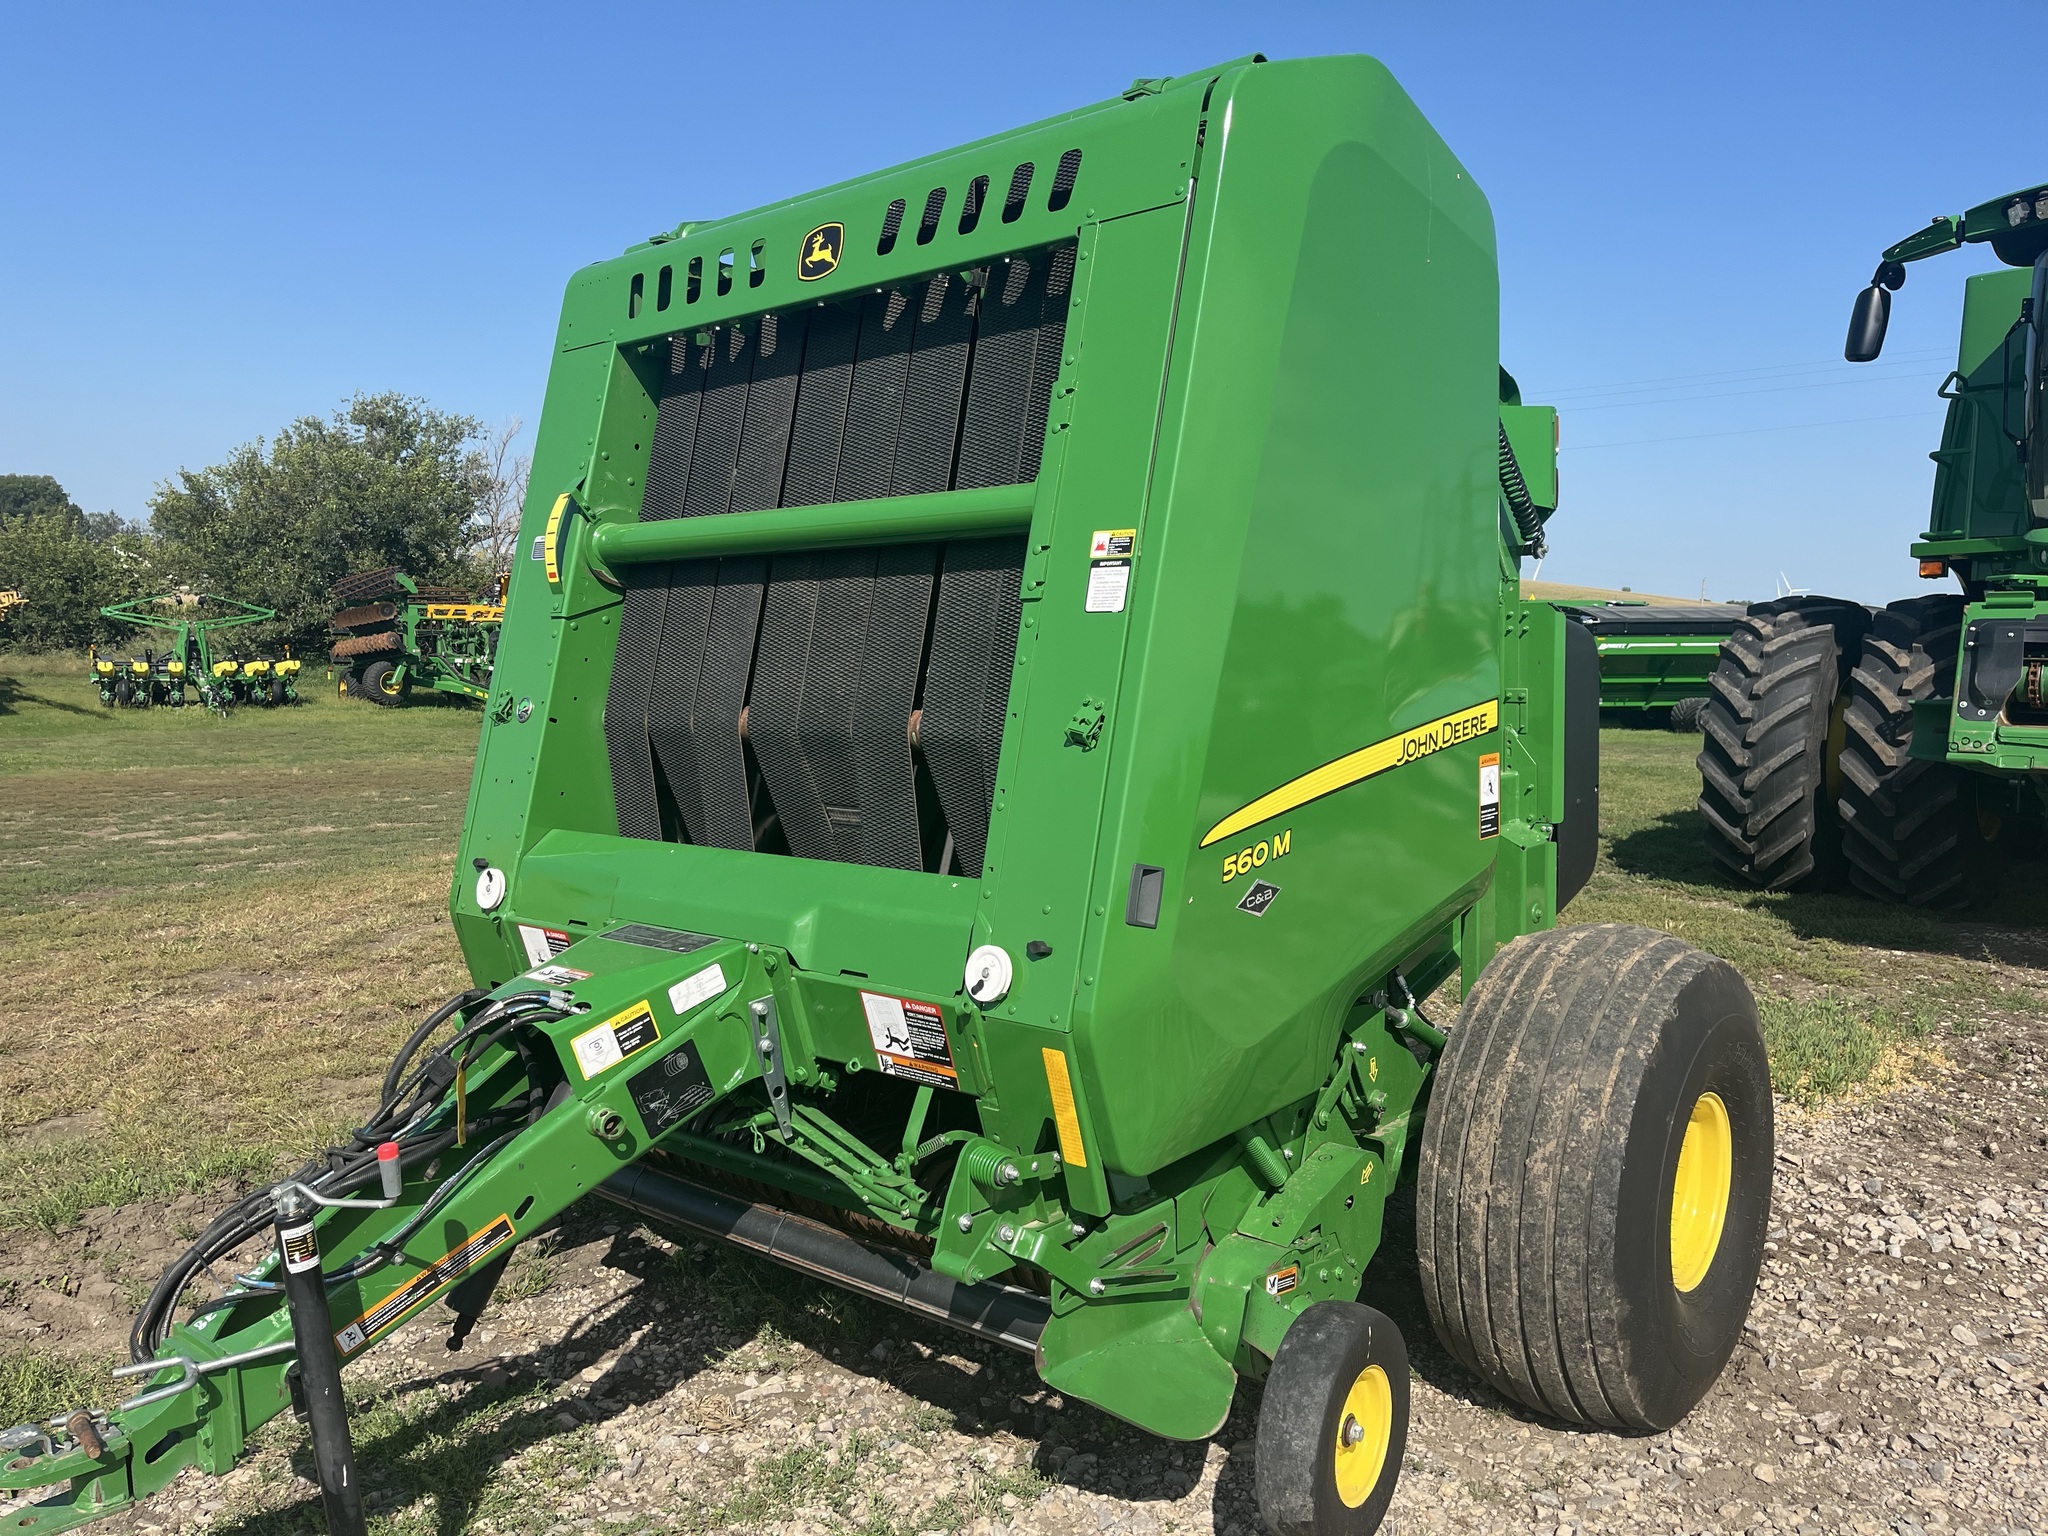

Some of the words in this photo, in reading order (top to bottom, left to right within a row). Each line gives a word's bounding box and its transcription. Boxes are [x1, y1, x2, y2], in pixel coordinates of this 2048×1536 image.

[1396, 729, 1439, 763] JOHN
[1442, 712, 1488, 745] DEERE
[1222, 840, 1270, 884] 560
[1272, 828, 1292, 861] M
[1246, 888, 1273, 908] C&B
[621, 1007, 645, 1022] CAUTION
[911, 1003, 937, 1015] DANGER
[912, 1061, 939, 1073] WARNING
[420, 1254, 450, 1277] WARNING
